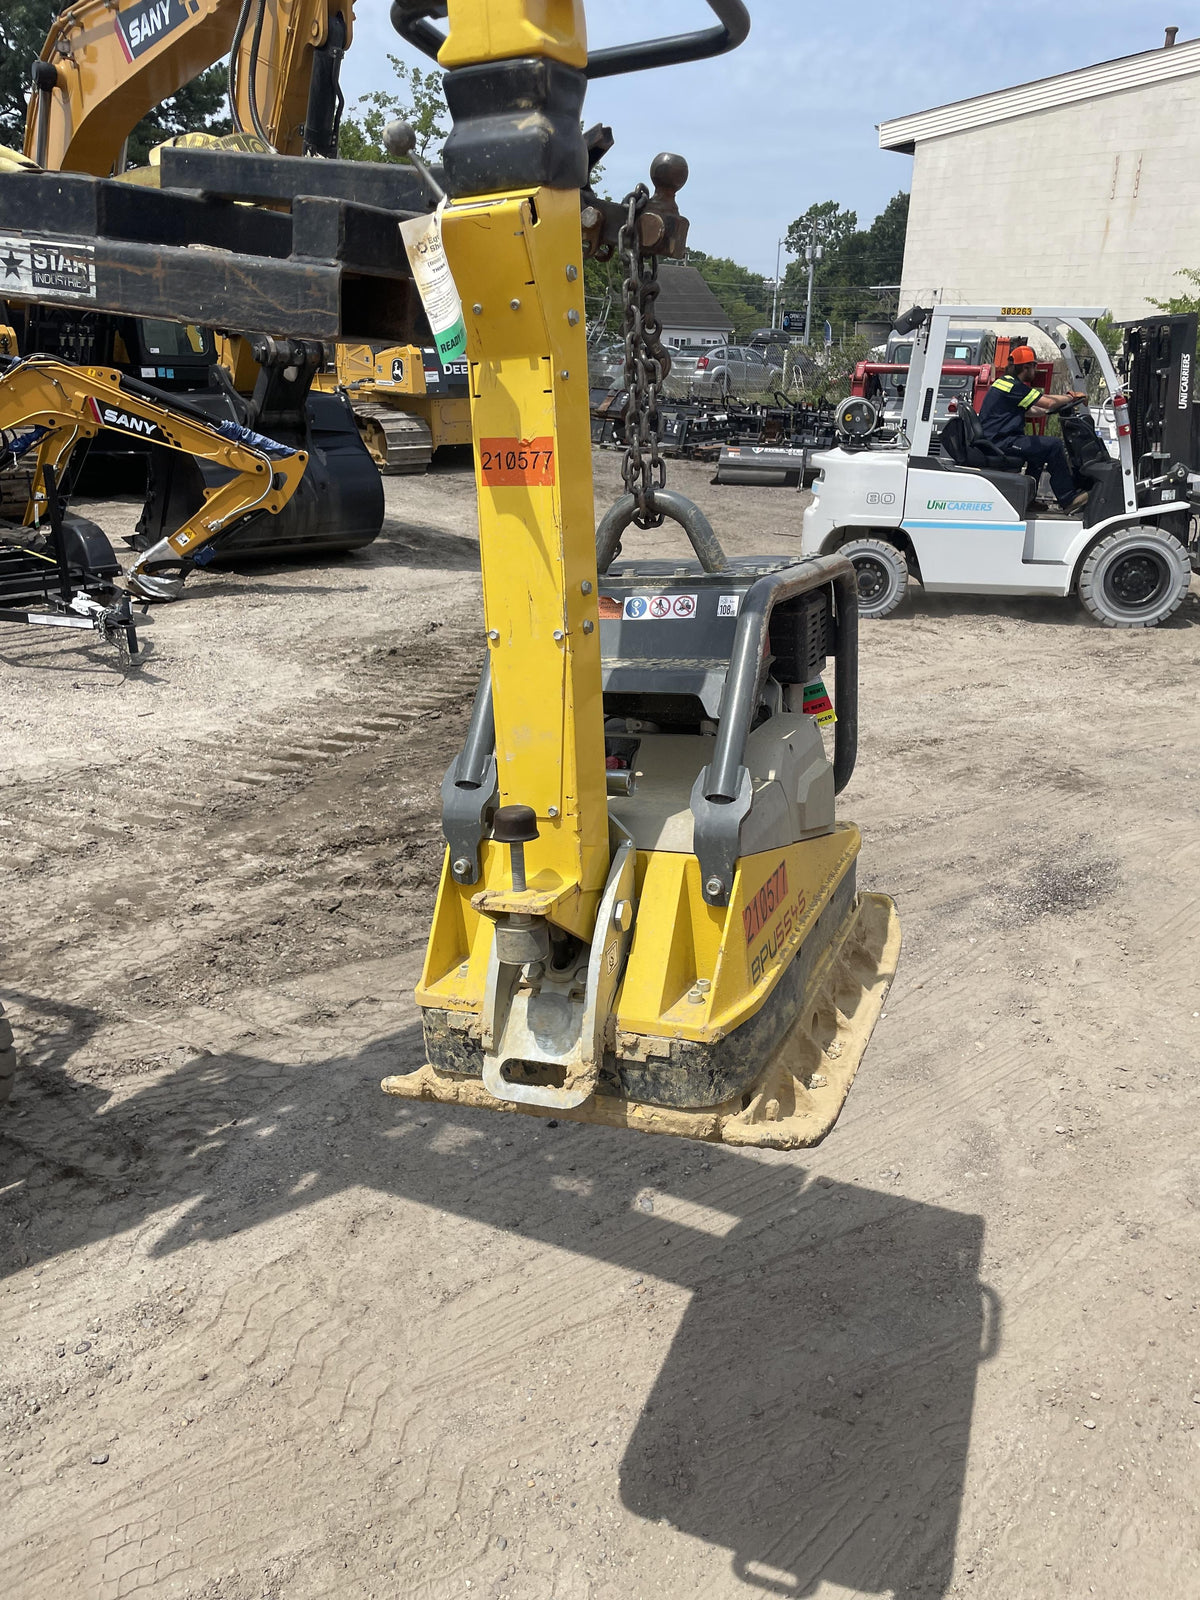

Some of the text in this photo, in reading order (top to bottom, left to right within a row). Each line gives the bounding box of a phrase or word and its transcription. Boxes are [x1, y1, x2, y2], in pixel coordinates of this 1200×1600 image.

[128, 0, 171, 48] SANY
[33, 247, 87, 274] STAR
[35, 272, 88, 289] INDUSTRIES
[1001, 307, 1032, 315] 303263
[440, 334, 461, 354] READY
[443, 363, 469, 375] DEE
[104, 409, 157, 435] SANY
[482, 451, 553, 470] 210577
[744, 859, 786, 945] 210577
